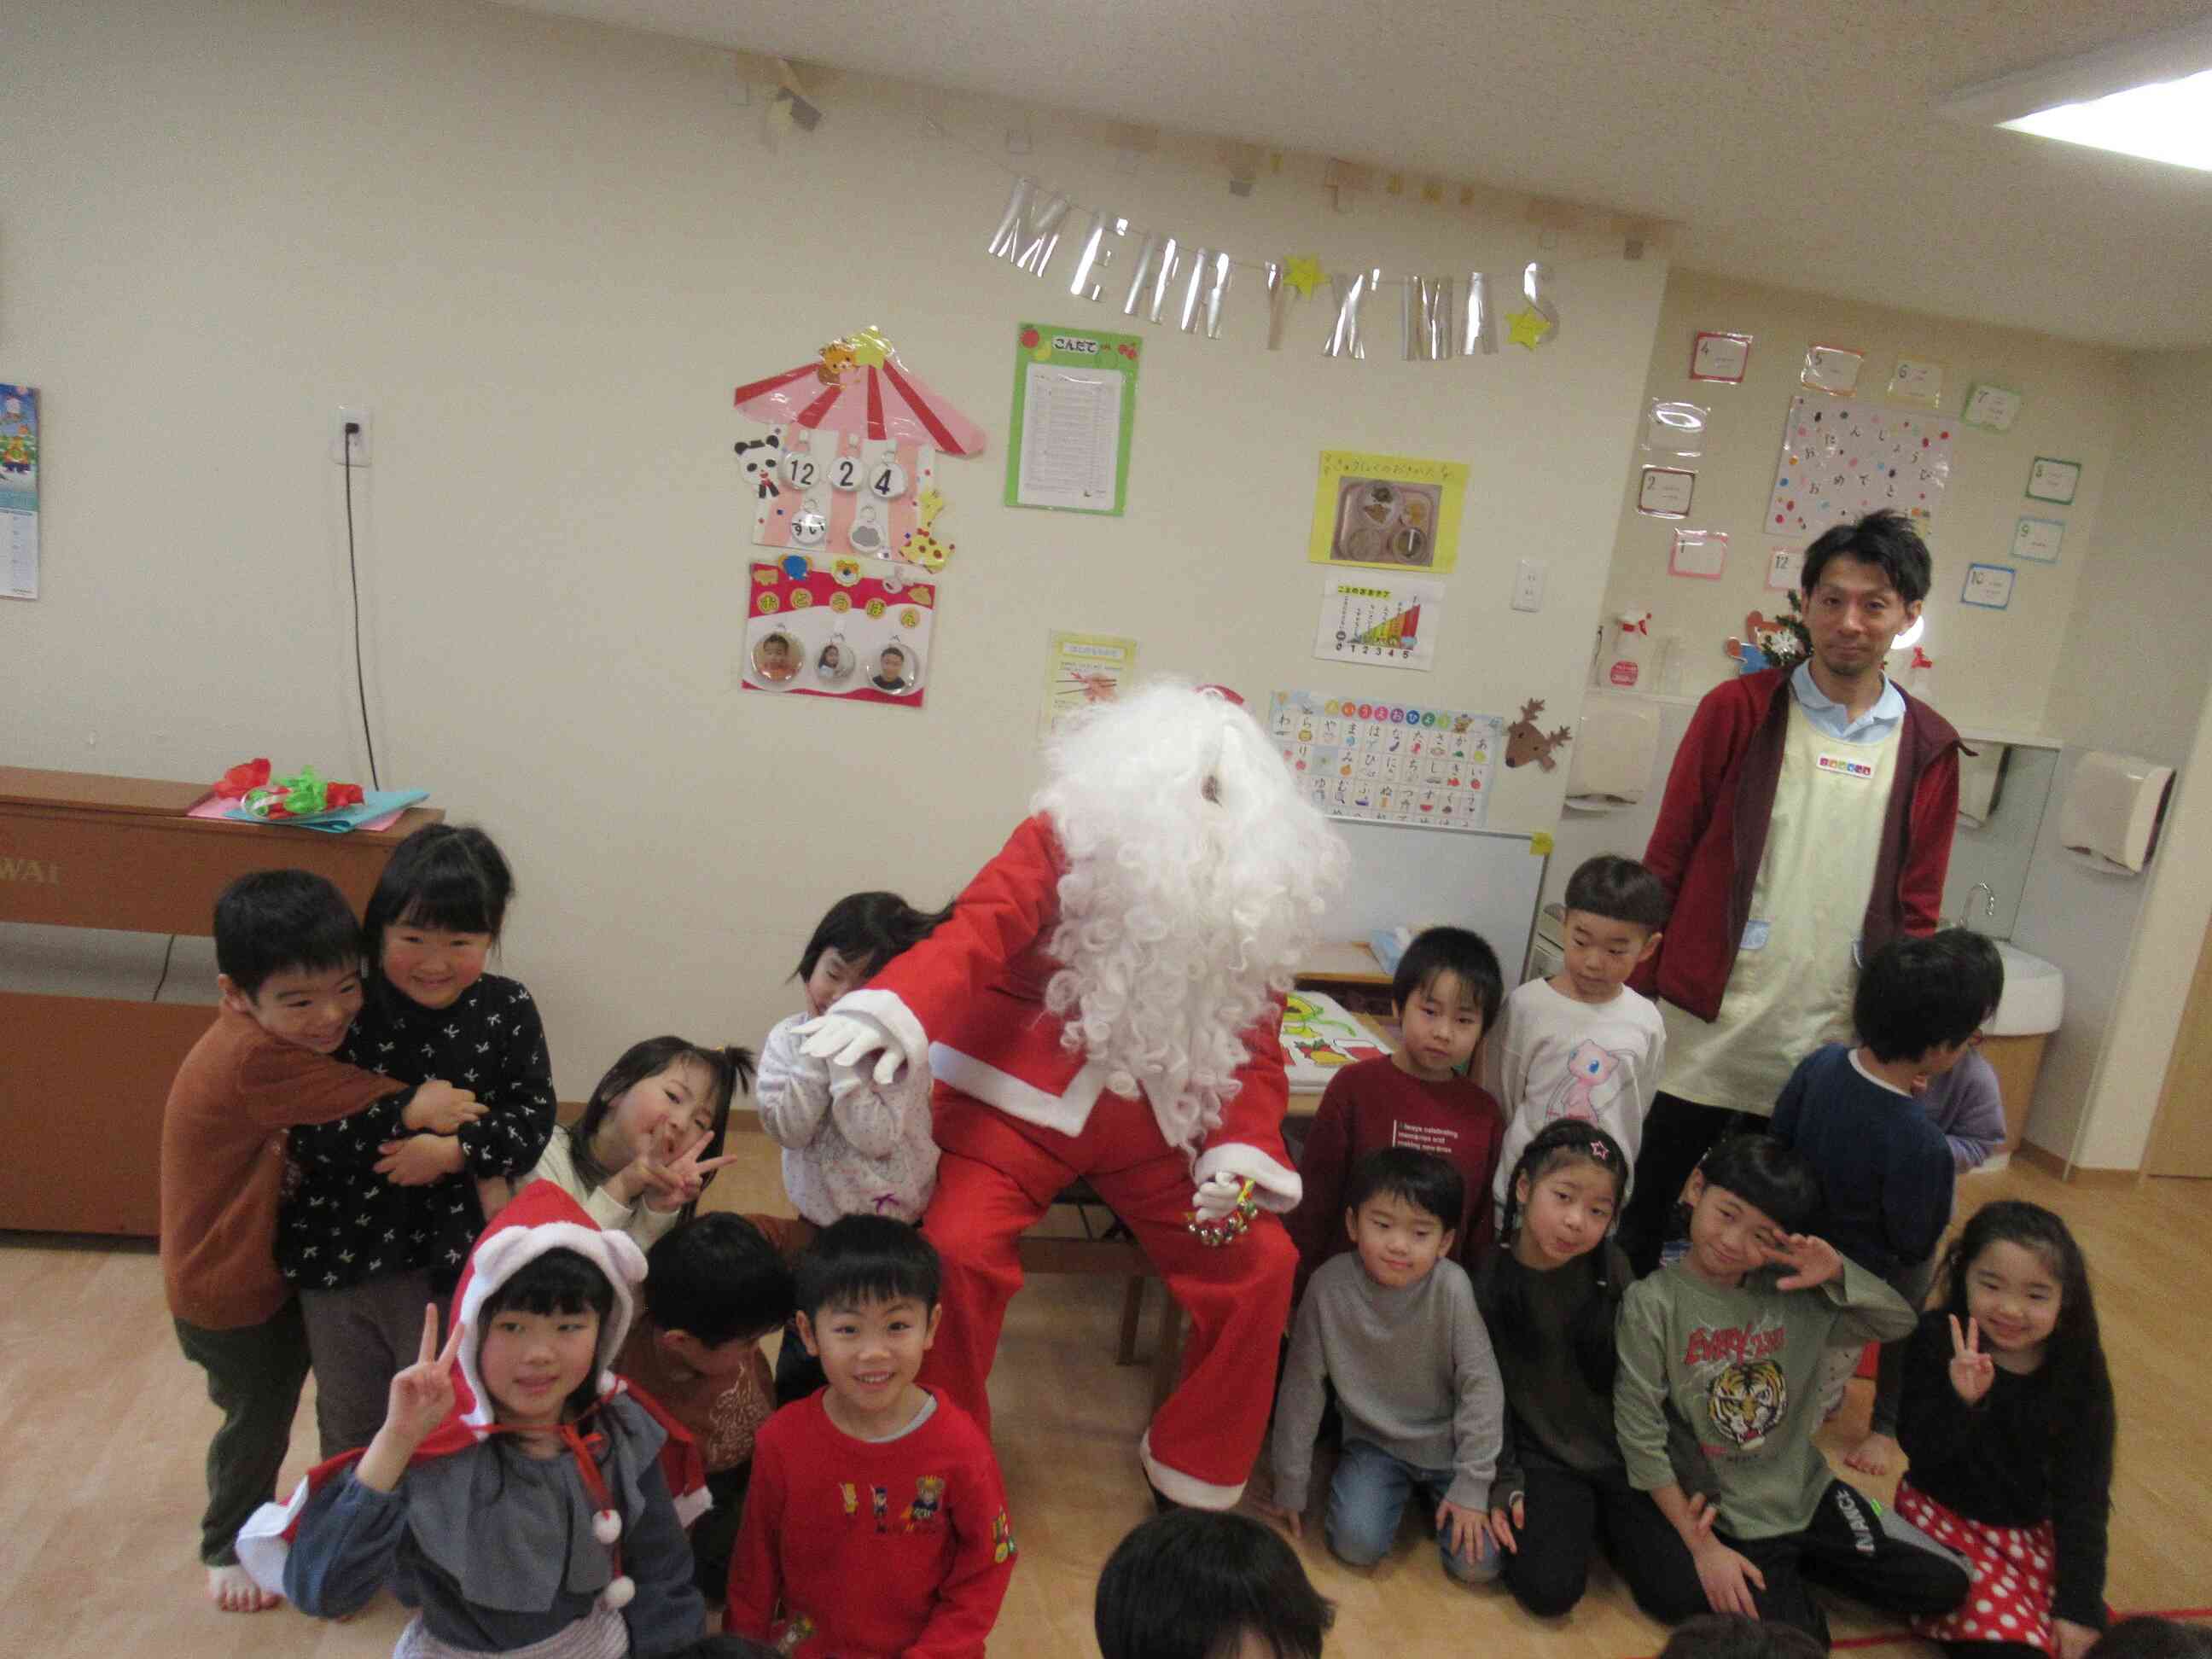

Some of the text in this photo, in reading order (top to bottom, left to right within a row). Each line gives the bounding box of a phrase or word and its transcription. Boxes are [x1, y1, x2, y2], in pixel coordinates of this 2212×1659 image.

[1055, 338, 1097, 352] こんだて
[1813, 351, 1825, 366] 5
[1898, 364, 1908, 379] 6
[1977, 390, 1988, 404] 7
[789, 459, 893, 495] 12 2 4
[1646, 475, 1656, 490] 2
[1775, 556, 1789, 569] 12
